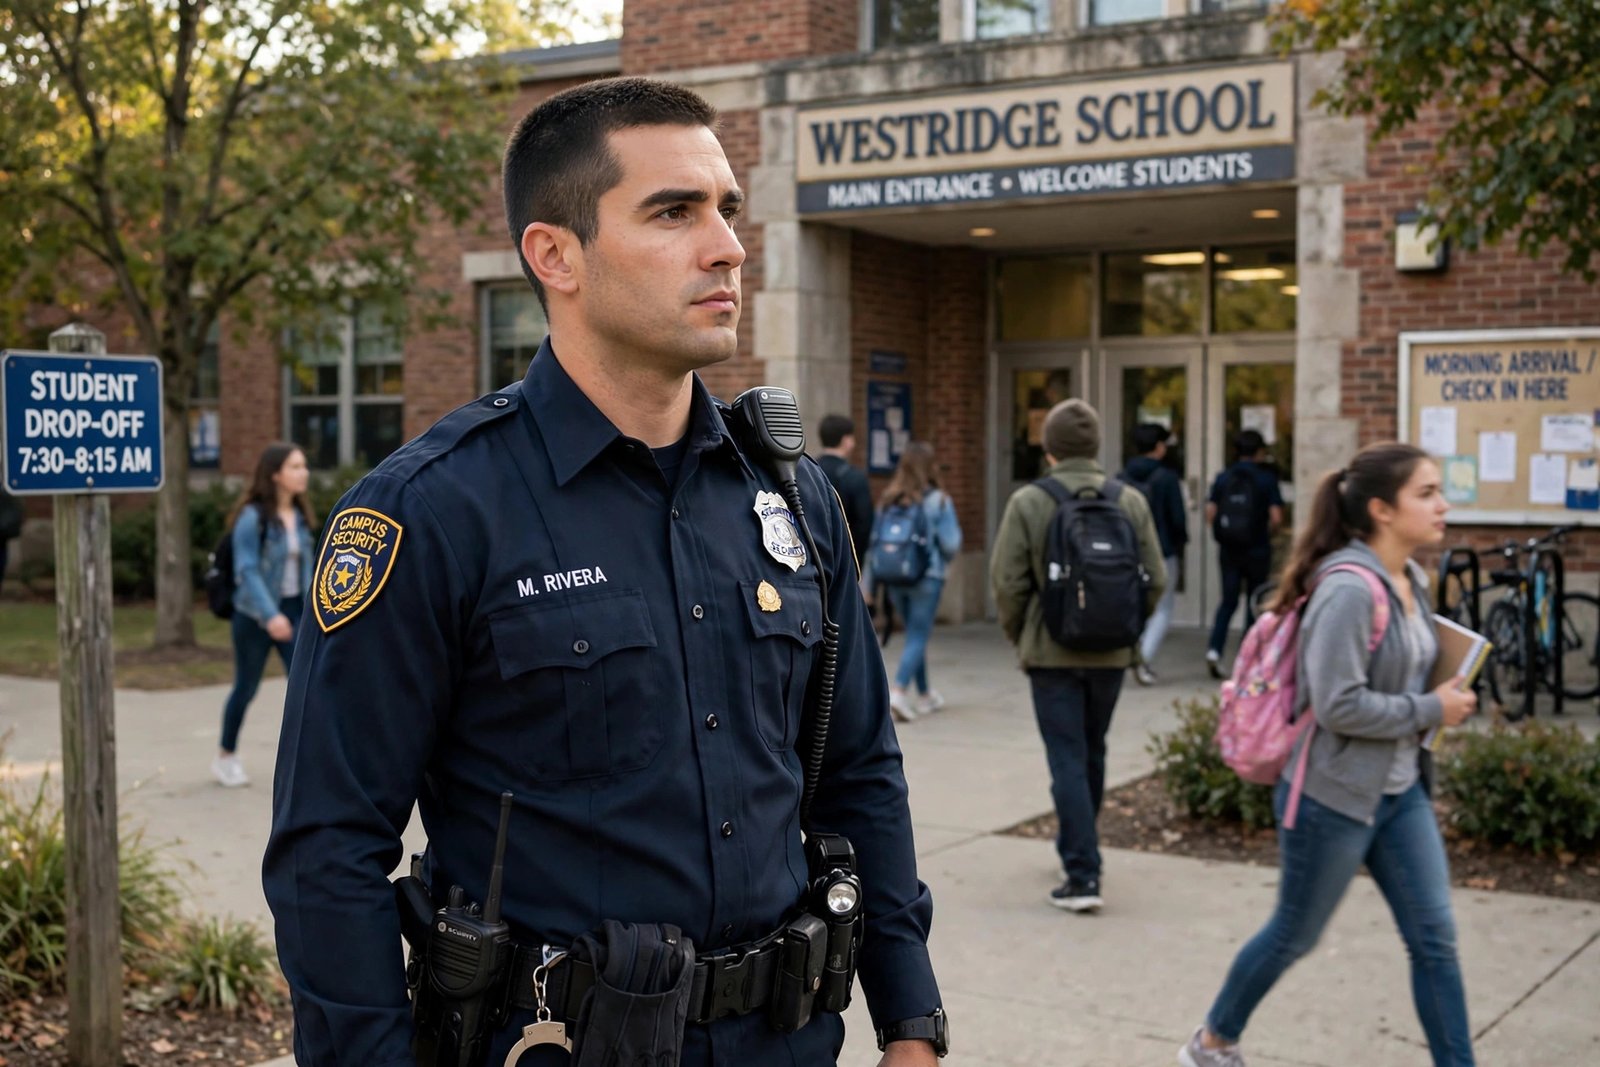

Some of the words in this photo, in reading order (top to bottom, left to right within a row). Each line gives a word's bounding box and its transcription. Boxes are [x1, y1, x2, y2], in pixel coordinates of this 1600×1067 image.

[810, 101, 1062, 166] WESTRIDGE
[1076, 79, 1276, 145] SCHOOL
[828, 182, 881, 207] MAIN
[884, 172, 993, 205] ENTRANCE
[1018, 158, 1128, 194] WELCOME
[1132, 152, 1253, 187] STUDENTS
[1424, 351, 1504, 376] MORNING
[1508, 349, 1582, 374] ARRIVAL
[30, 370, 138, 402] STUDENT
[1441, 379, 1497, 402] CHECK
[1502, 380, 1519, 401] IN
[1524, 377, 1569, 401] HERE
[25, 408, 145, 438] DROP-OFF
[120, 446, 152, 474] AM
[339, 515, 388, 538] CAMPUS
[331, 531, 388, 555] SECURITY
[516, 577, 540, 598] M.
[543, 566, 608, 593] RIVERA
